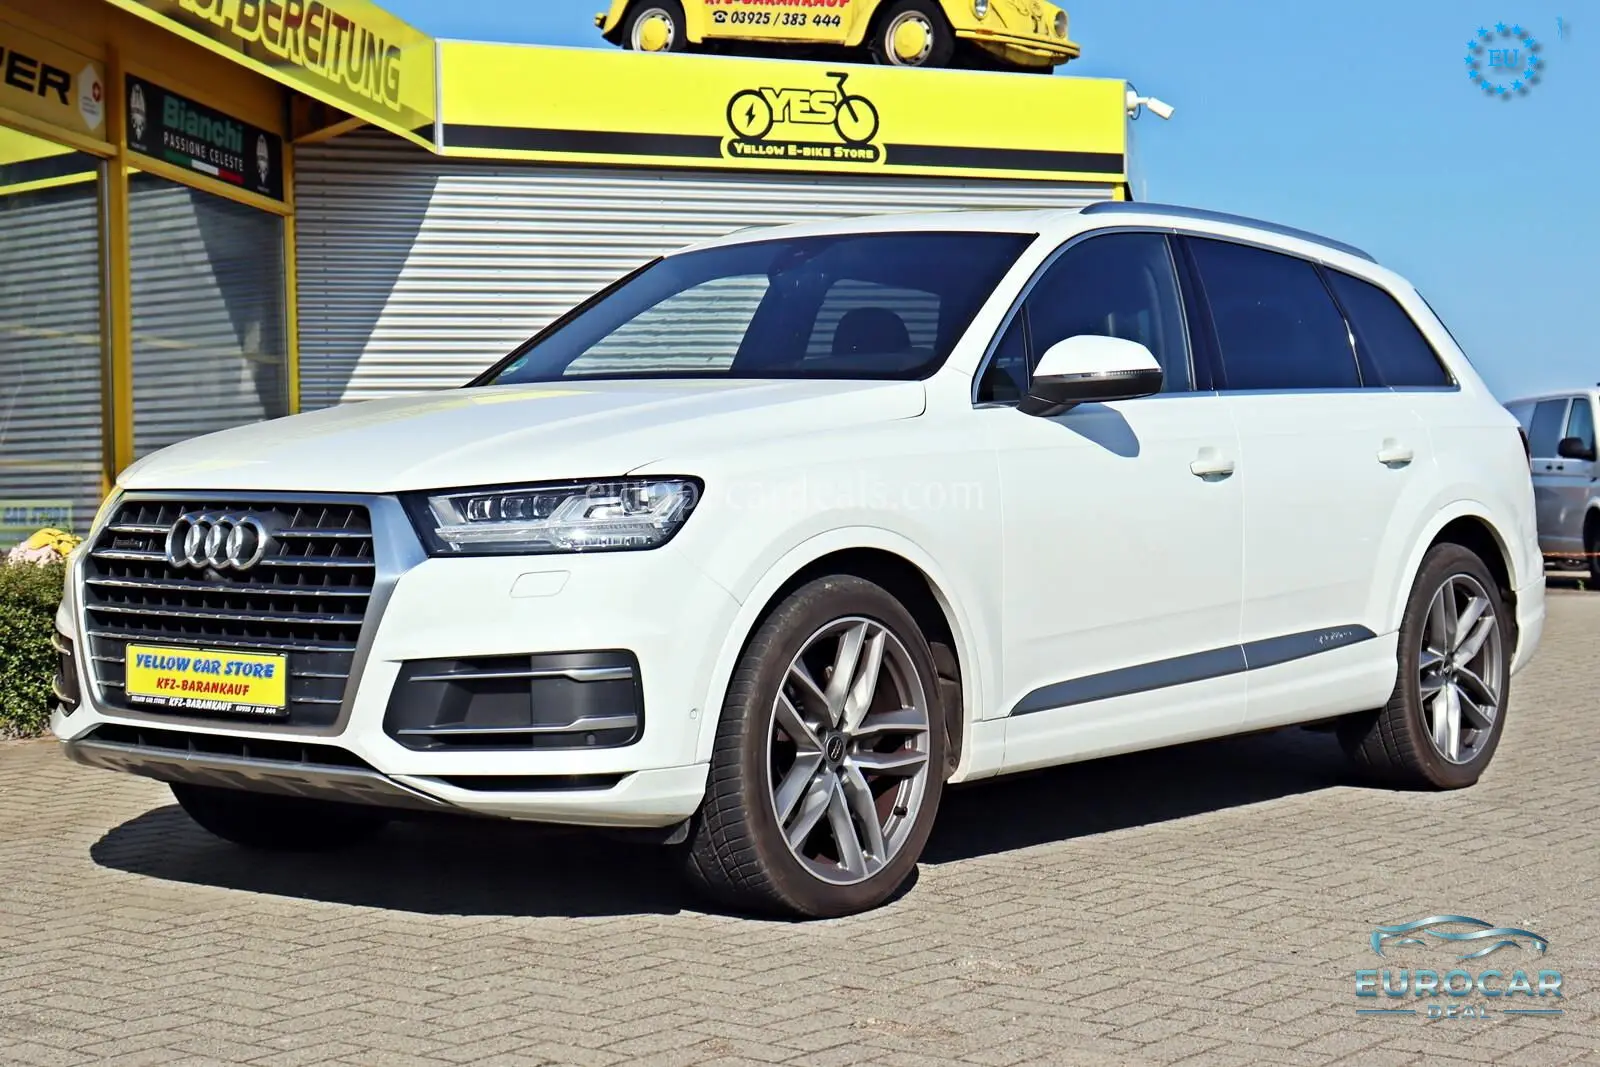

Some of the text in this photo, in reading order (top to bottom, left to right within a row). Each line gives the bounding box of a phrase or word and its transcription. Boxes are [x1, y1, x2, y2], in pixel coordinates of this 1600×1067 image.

[731, 11, 771, 24] 03925
[782, 13, 807, 25] 383
[813, 14, 841, 26] 444
[181, 0, 401, 109] BEREITUNG
[0, 45, 69, 106] ER
[163, 95, 243, 153] Bianchi
[759, 87, 838, 125] YES
[164, 131, 244, 172] PASSIONE CELESTE
[136, 653, 275, 678] YELLOW CAR STORE
[157, 677, 249, 696] KFZ-BARANKAUF
[168, 697, 232, 711] KFZ-BARANKAUF
